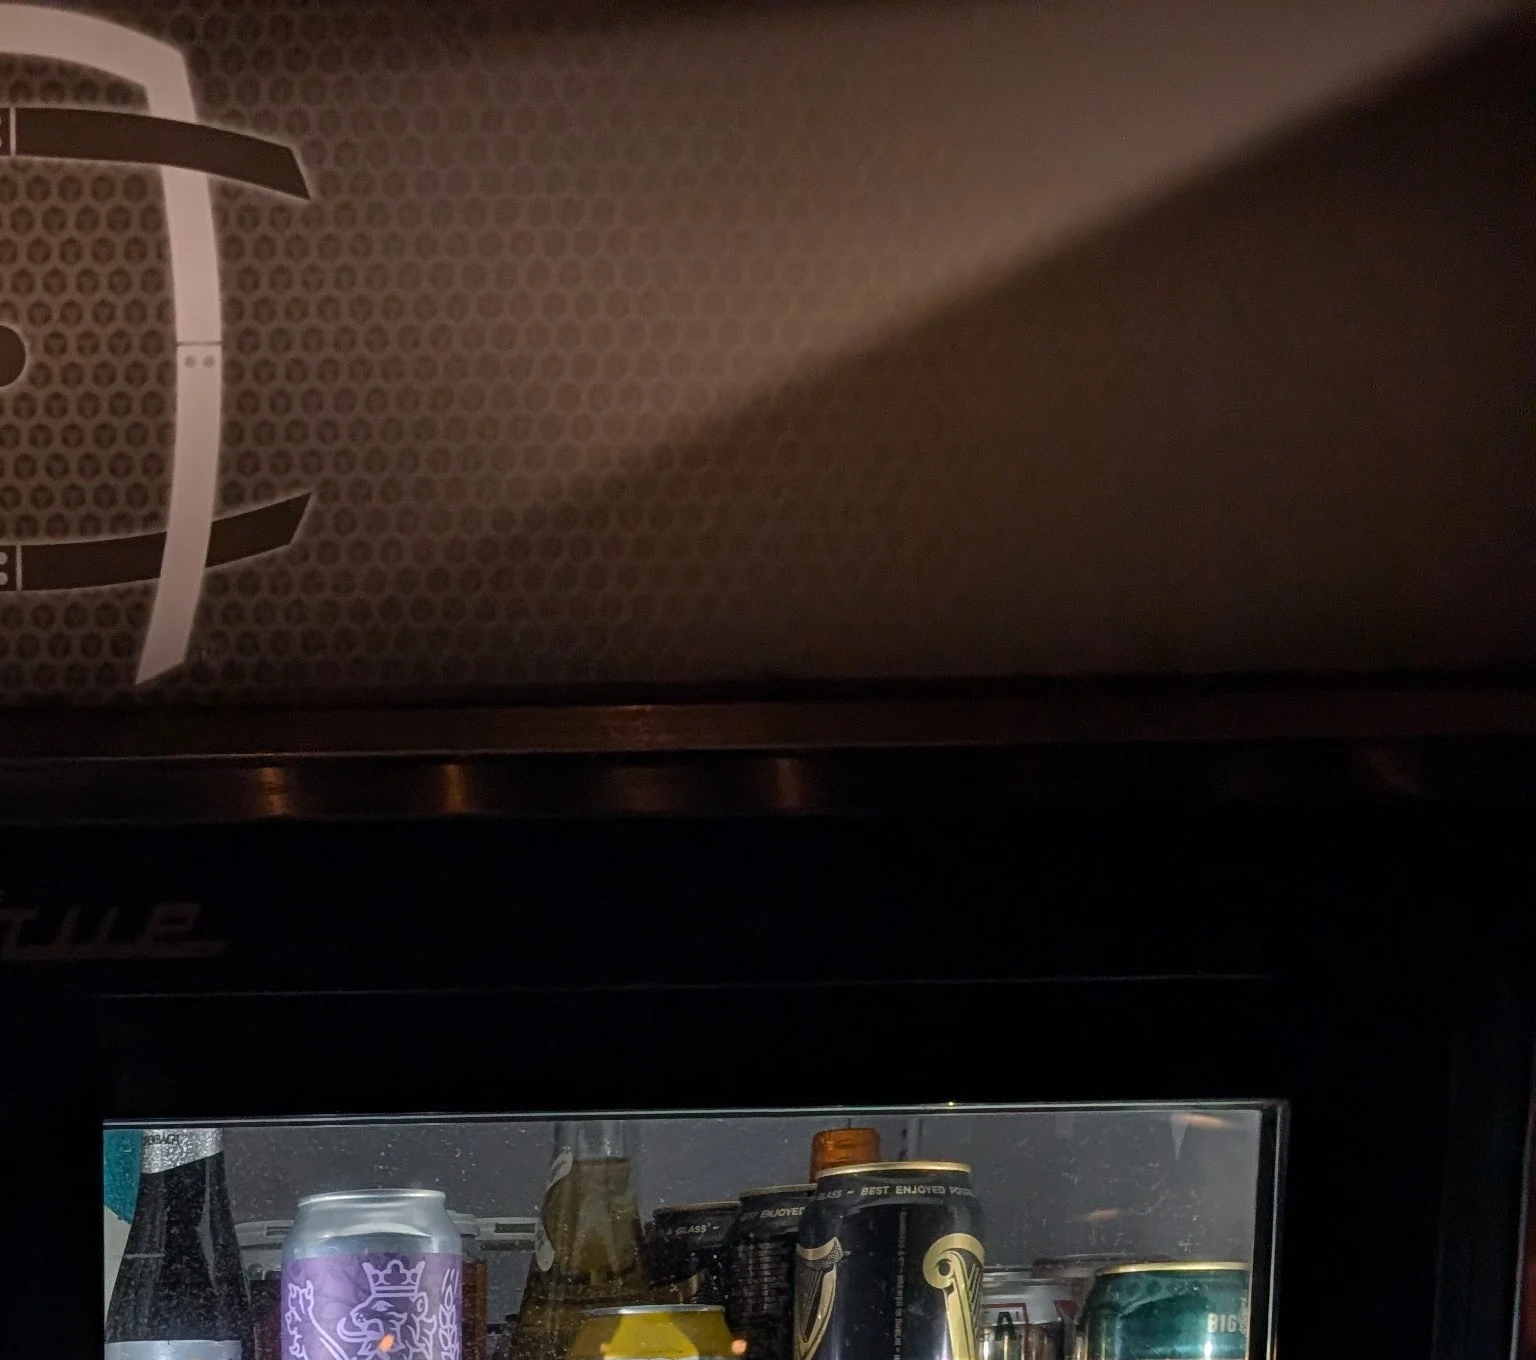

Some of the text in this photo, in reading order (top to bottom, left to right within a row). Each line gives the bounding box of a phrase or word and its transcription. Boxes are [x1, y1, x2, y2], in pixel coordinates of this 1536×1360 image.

[860, 1185, 888, 1197] BEST
[895, 1185, 945, 1195] ENJOYED
[1208, 1314, 1237, 1333] BIG
